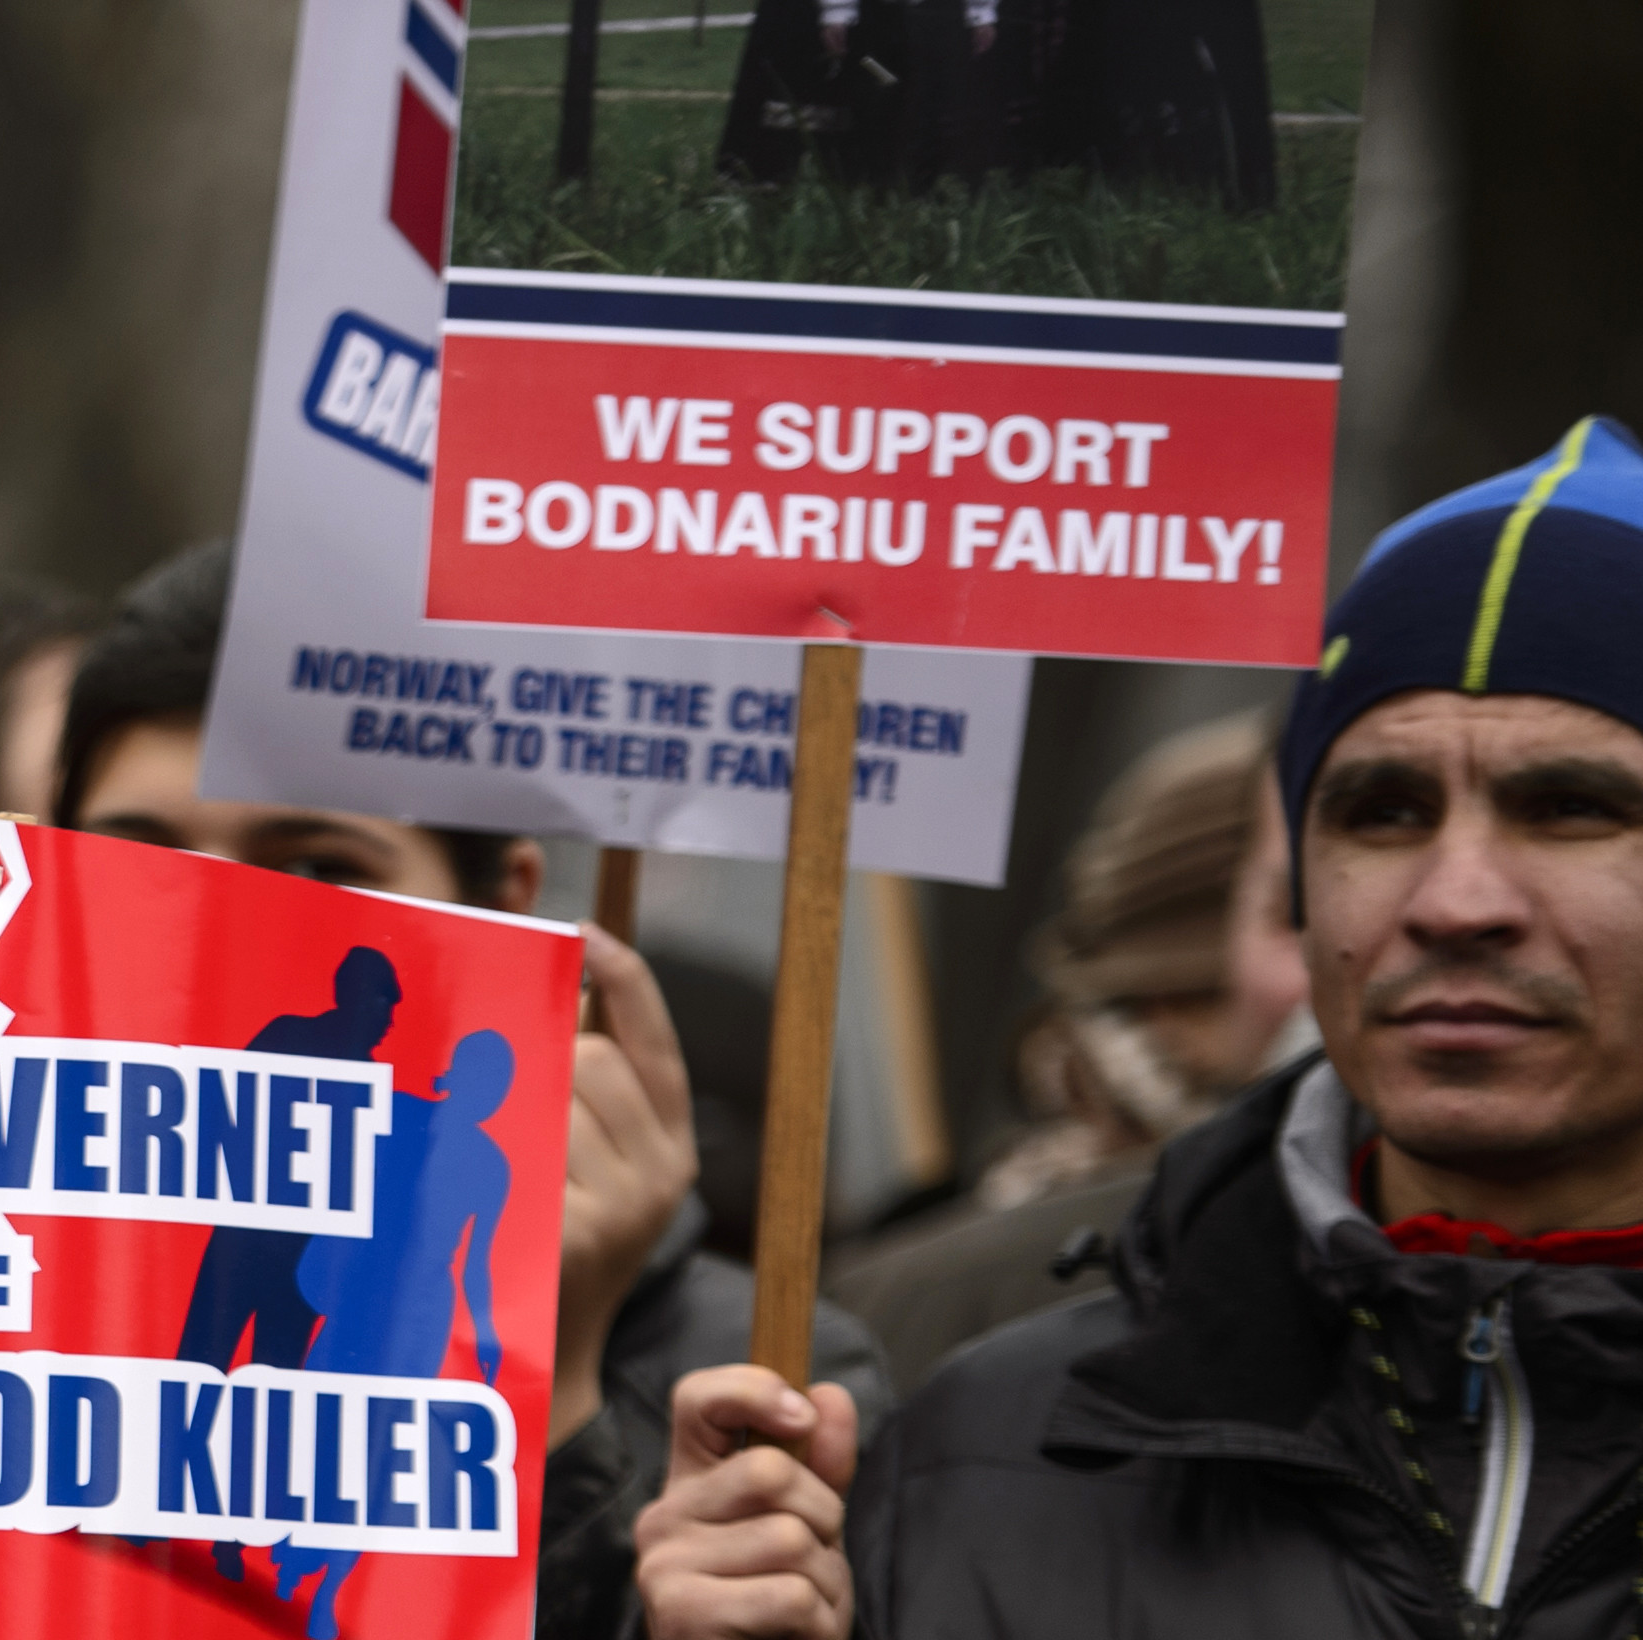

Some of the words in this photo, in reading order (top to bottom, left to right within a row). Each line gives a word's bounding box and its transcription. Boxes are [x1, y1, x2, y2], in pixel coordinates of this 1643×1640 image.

[595, 394, 734, 468] WE
[755, 402, 1169, 488] SUPPORT
[463, 478, 927, 569] BODNARIU
[950, 503, 1284, 586] FAMILY!
[290, 645, 496, 720] NORWAY,
[512, 666, 609, 719] GIVE
[627, 678, 714, 728] THE
[347, 706, 475, 763] BACK
[491, 722, 544, 769] TO
[558, 727, 690, 781] THEIR
[157, 1381, 502, 1532] KILLER
